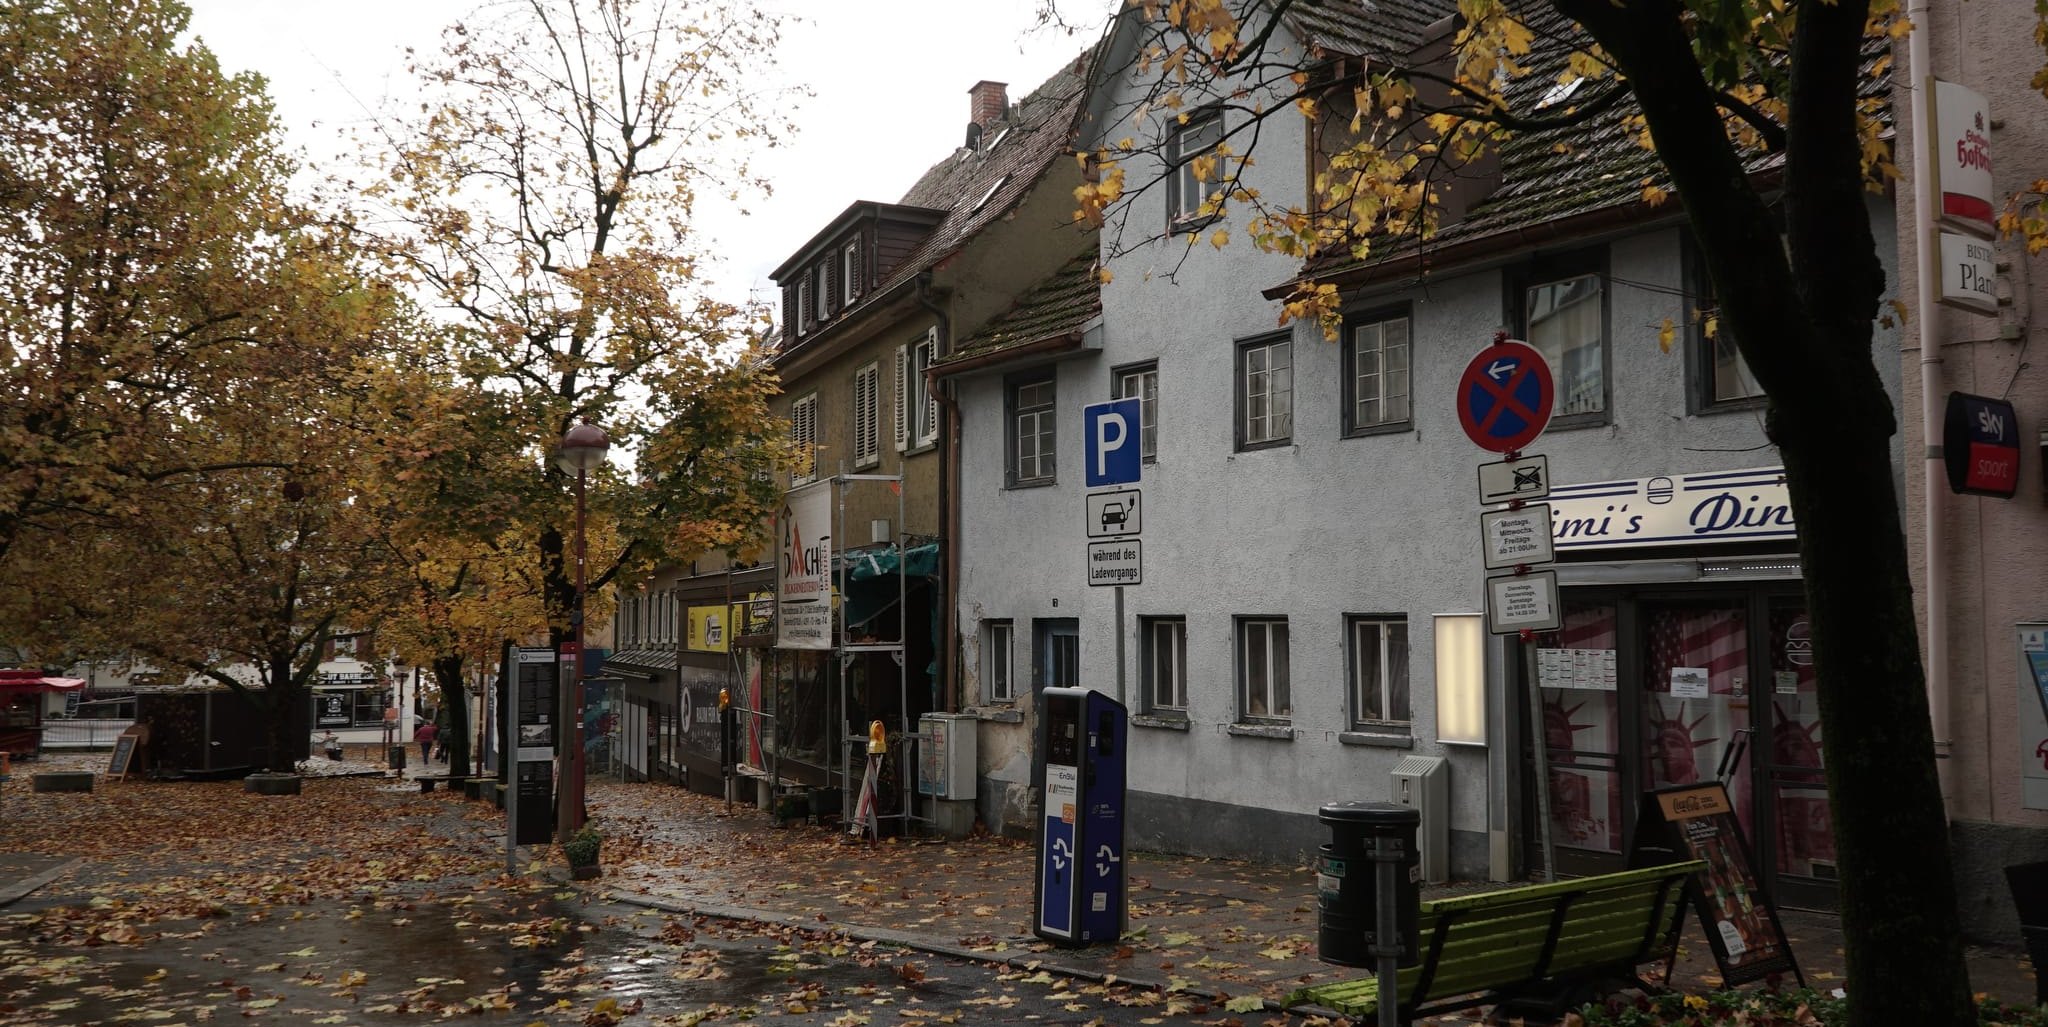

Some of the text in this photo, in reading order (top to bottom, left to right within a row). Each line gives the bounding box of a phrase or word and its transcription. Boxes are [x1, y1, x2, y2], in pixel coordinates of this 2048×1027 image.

[1967, 244, 1993, 263] BISTR
[1978, 406, 2004, 442] sky
[1097, 412, 1127, 476] P
[1977, 459, 2008, 479] sport
[1551, 504, 1643, 538] imi's
[1504, 536, 1530, 545] Freitags
[1093, 549, 1136, 562] während des
[1092, 567, 1138, 581] Ladevorgangs
